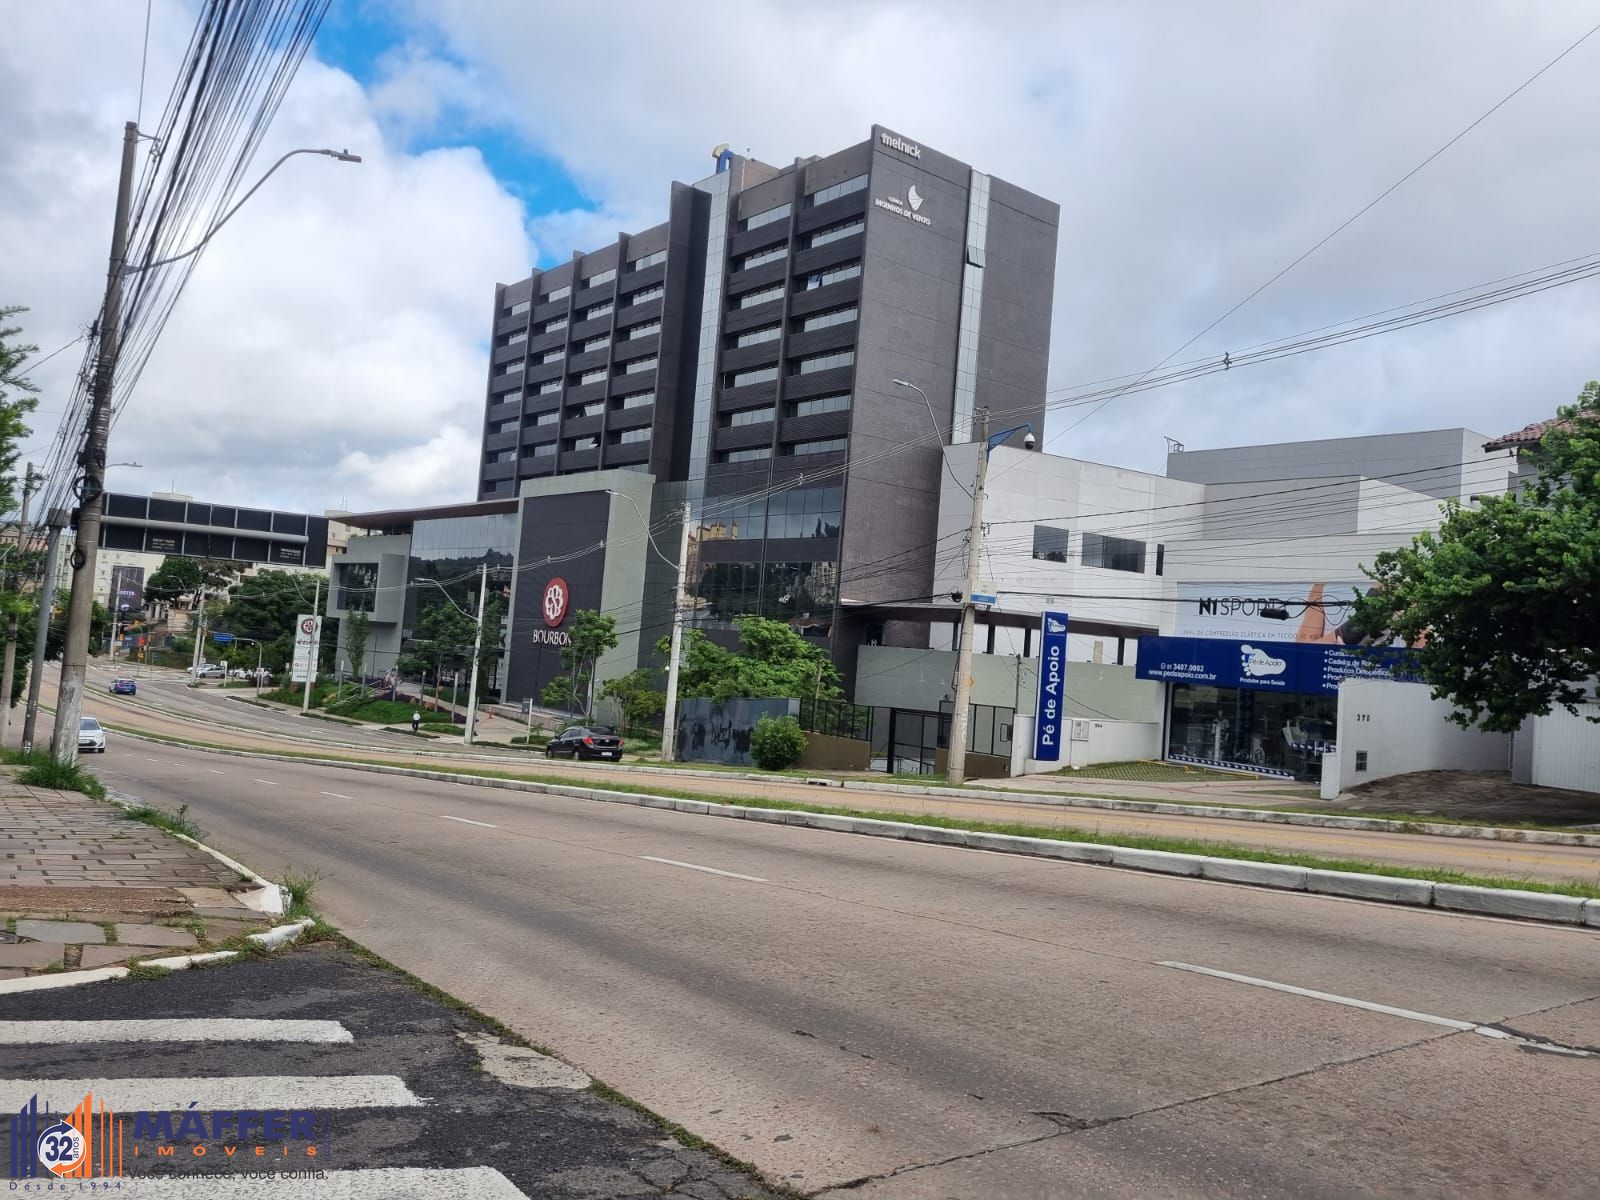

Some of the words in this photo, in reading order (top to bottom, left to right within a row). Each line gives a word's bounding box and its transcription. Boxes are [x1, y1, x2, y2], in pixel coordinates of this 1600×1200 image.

[881, 132, 921, 159] melnick
[532, 629, 572, 646] BOURBON
[1045, 645, 1061, 695] Apoio
[1044, 699, 1057, 719] de
[1042, 725, 1056, 746] Pé
